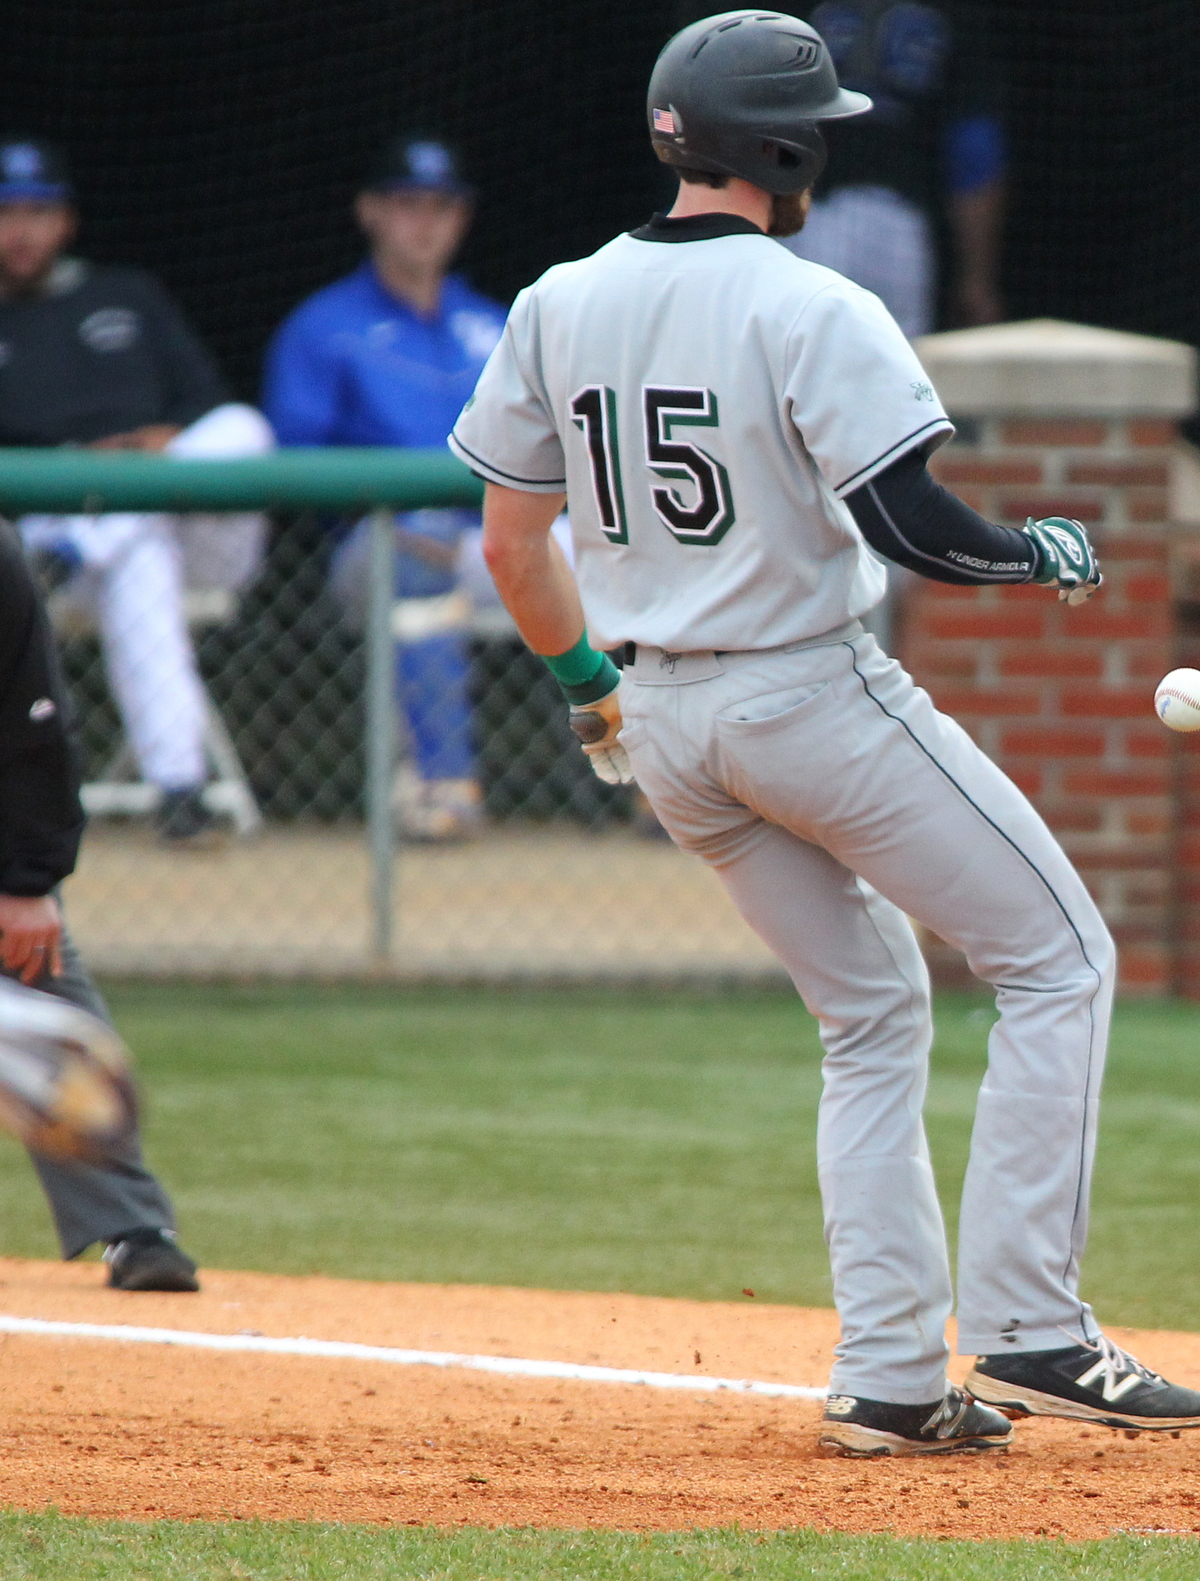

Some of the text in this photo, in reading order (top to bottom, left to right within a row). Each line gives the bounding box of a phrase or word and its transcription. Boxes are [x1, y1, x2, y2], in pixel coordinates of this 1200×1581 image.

[568, 383, 735, 545] 15
[956, 553, 1030, 571] UNDER ARMOUR
